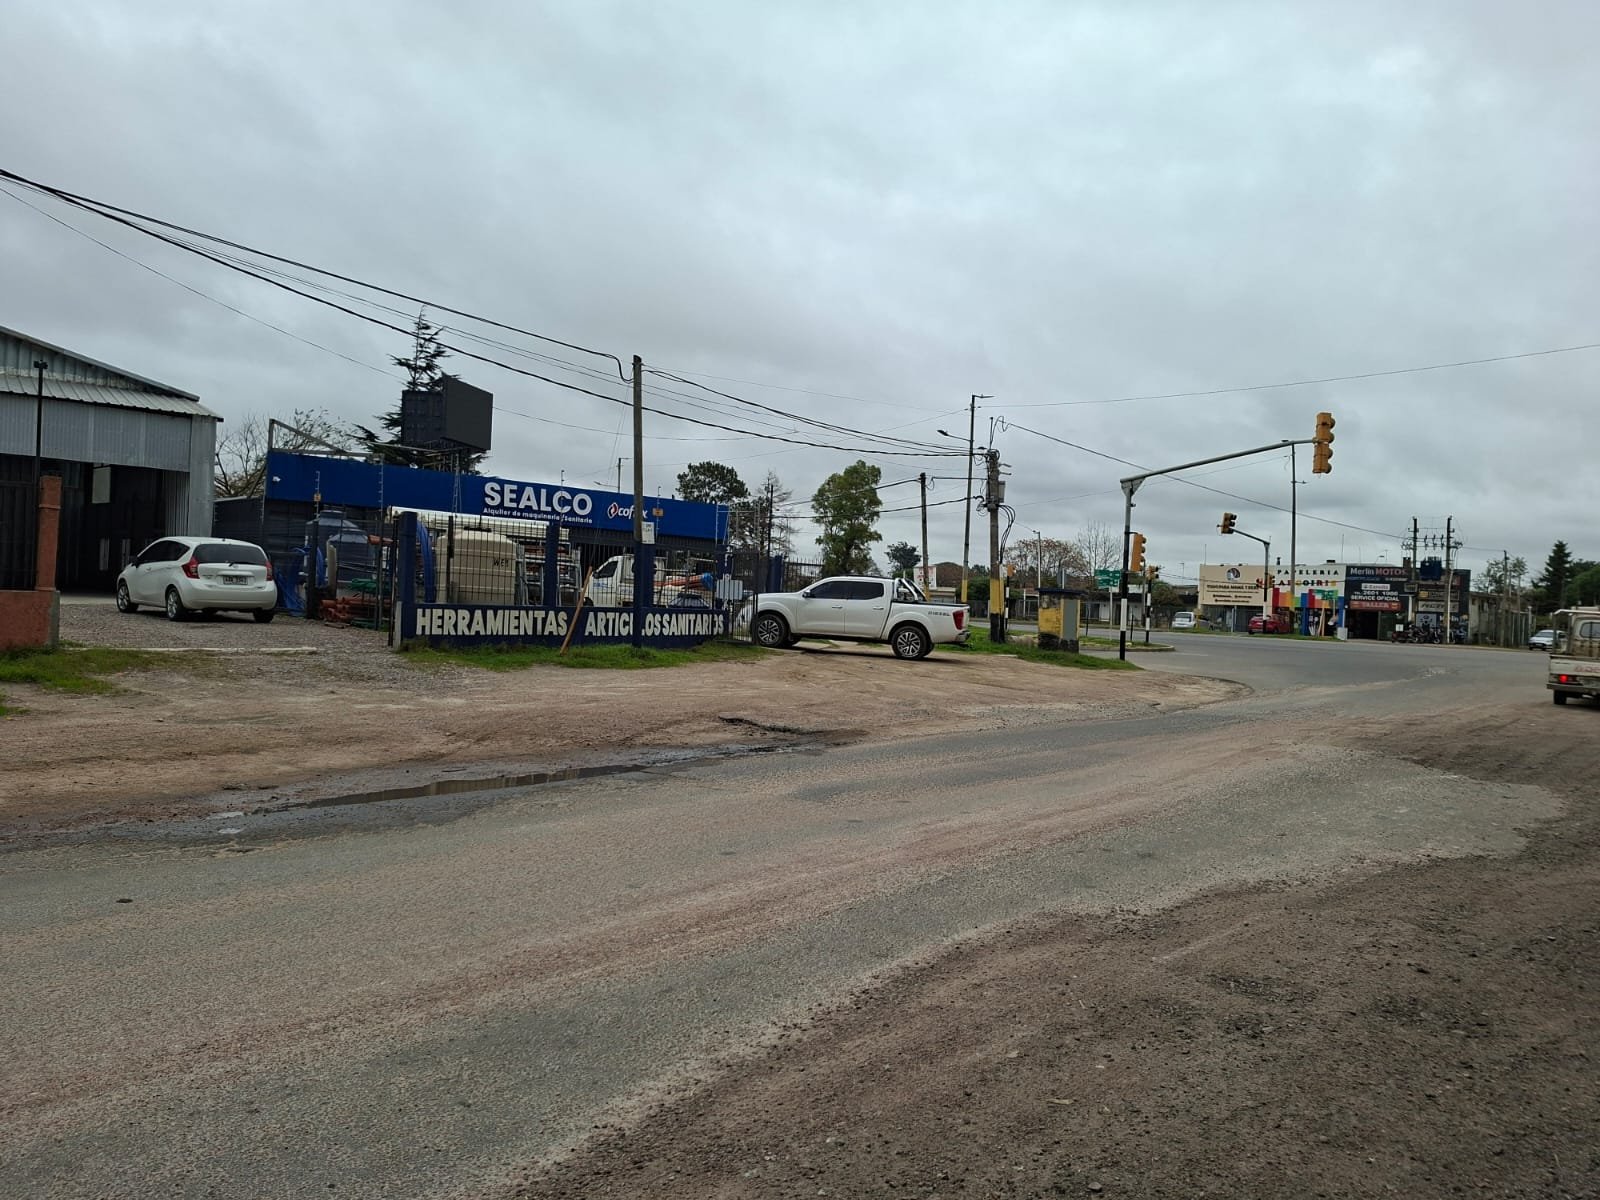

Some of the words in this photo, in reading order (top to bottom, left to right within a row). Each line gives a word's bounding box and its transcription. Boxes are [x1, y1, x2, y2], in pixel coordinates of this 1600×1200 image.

[484, 481, 593, 515] SEALCO
[483, 507, 511, 517] Alquiler
[522, 511, 560, 521] maquinaria
[618, 504, 648, 520] cofx
[1350, 567, 1375, 576] Merlin
[1375, 568, 1408, 577] MOTOS
[415, 608, 568, 636] HERRAMIENTAS
[584, 611, 662, 637] ARTICOS
